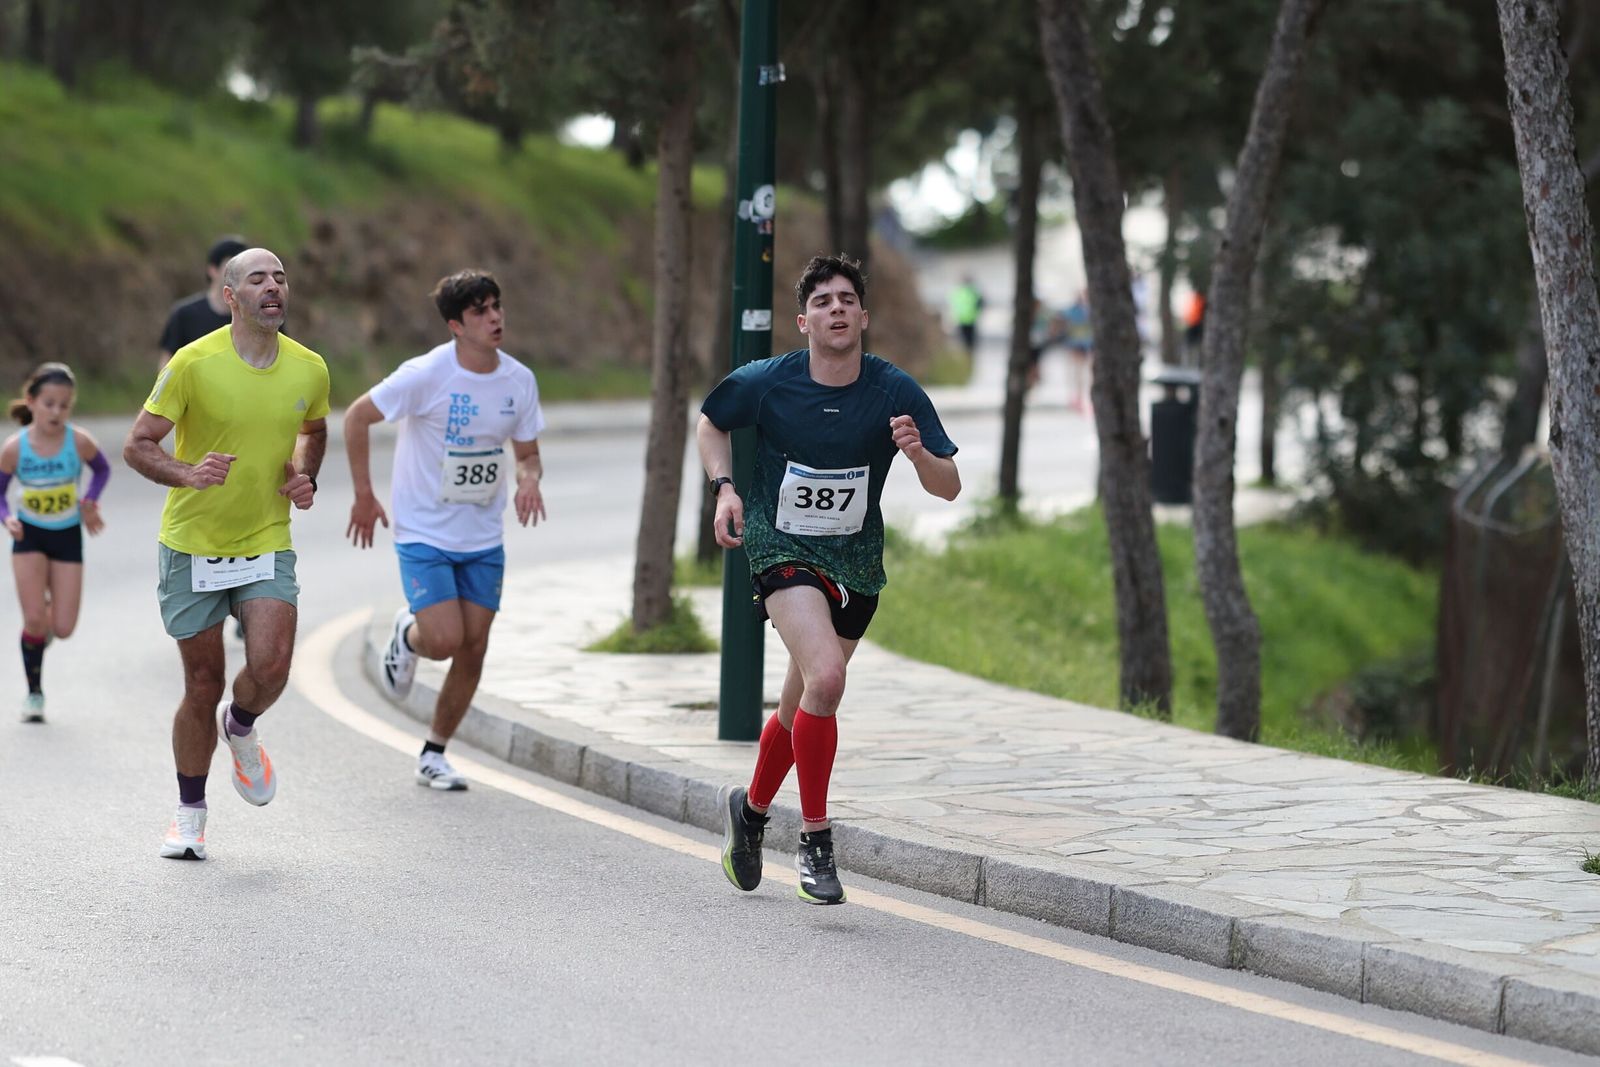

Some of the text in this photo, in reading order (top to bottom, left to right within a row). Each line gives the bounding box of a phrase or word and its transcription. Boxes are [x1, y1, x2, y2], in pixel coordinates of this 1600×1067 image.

[454, 463, 498, 486] 388
[28, 493, 72, 514] 928
[794, 486, 856, 512] 387
